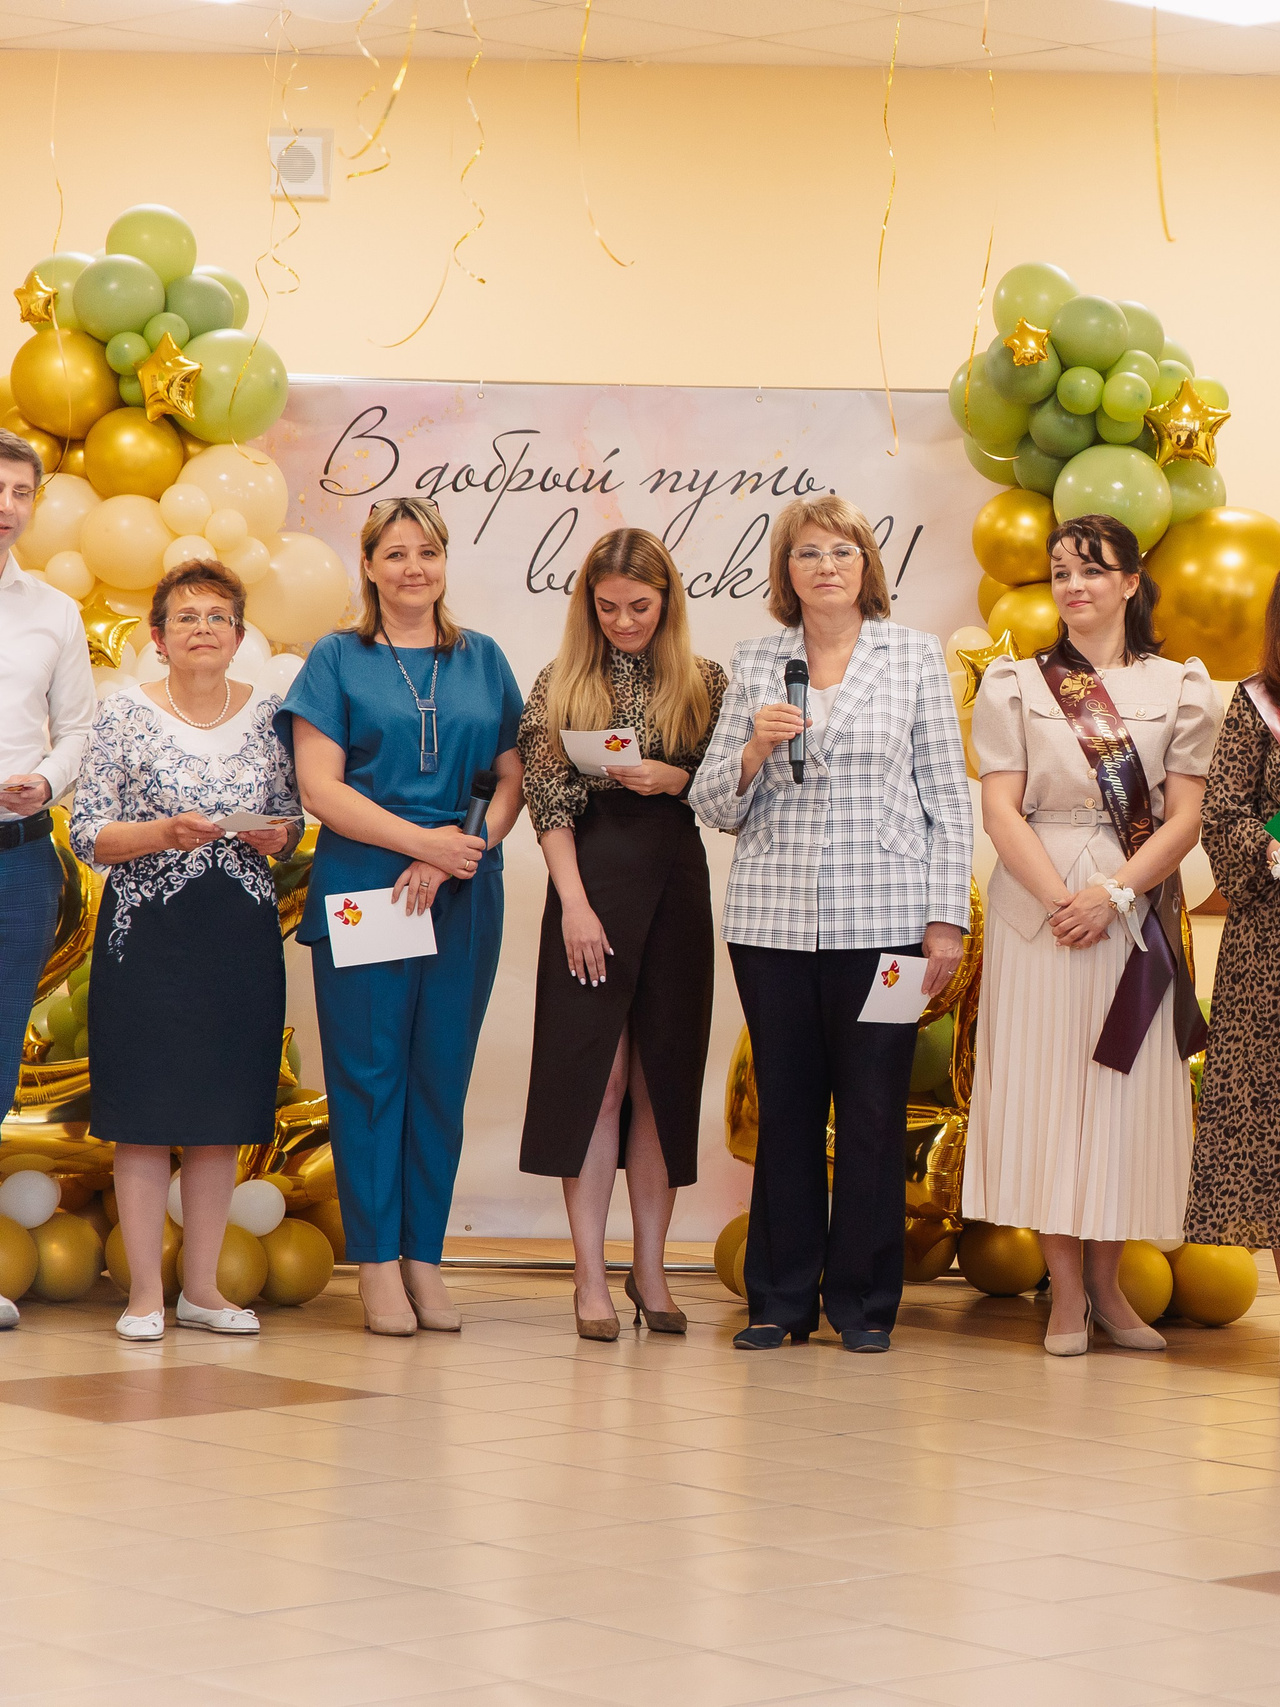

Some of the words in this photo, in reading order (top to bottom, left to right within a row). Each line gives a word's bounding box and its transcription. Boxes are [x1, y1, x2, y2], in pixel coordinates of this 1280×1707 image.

[319, 405, 399, 497] В
[415, 430, 625, 546] добрый
[1085, 699, 1130, 763] Классный
